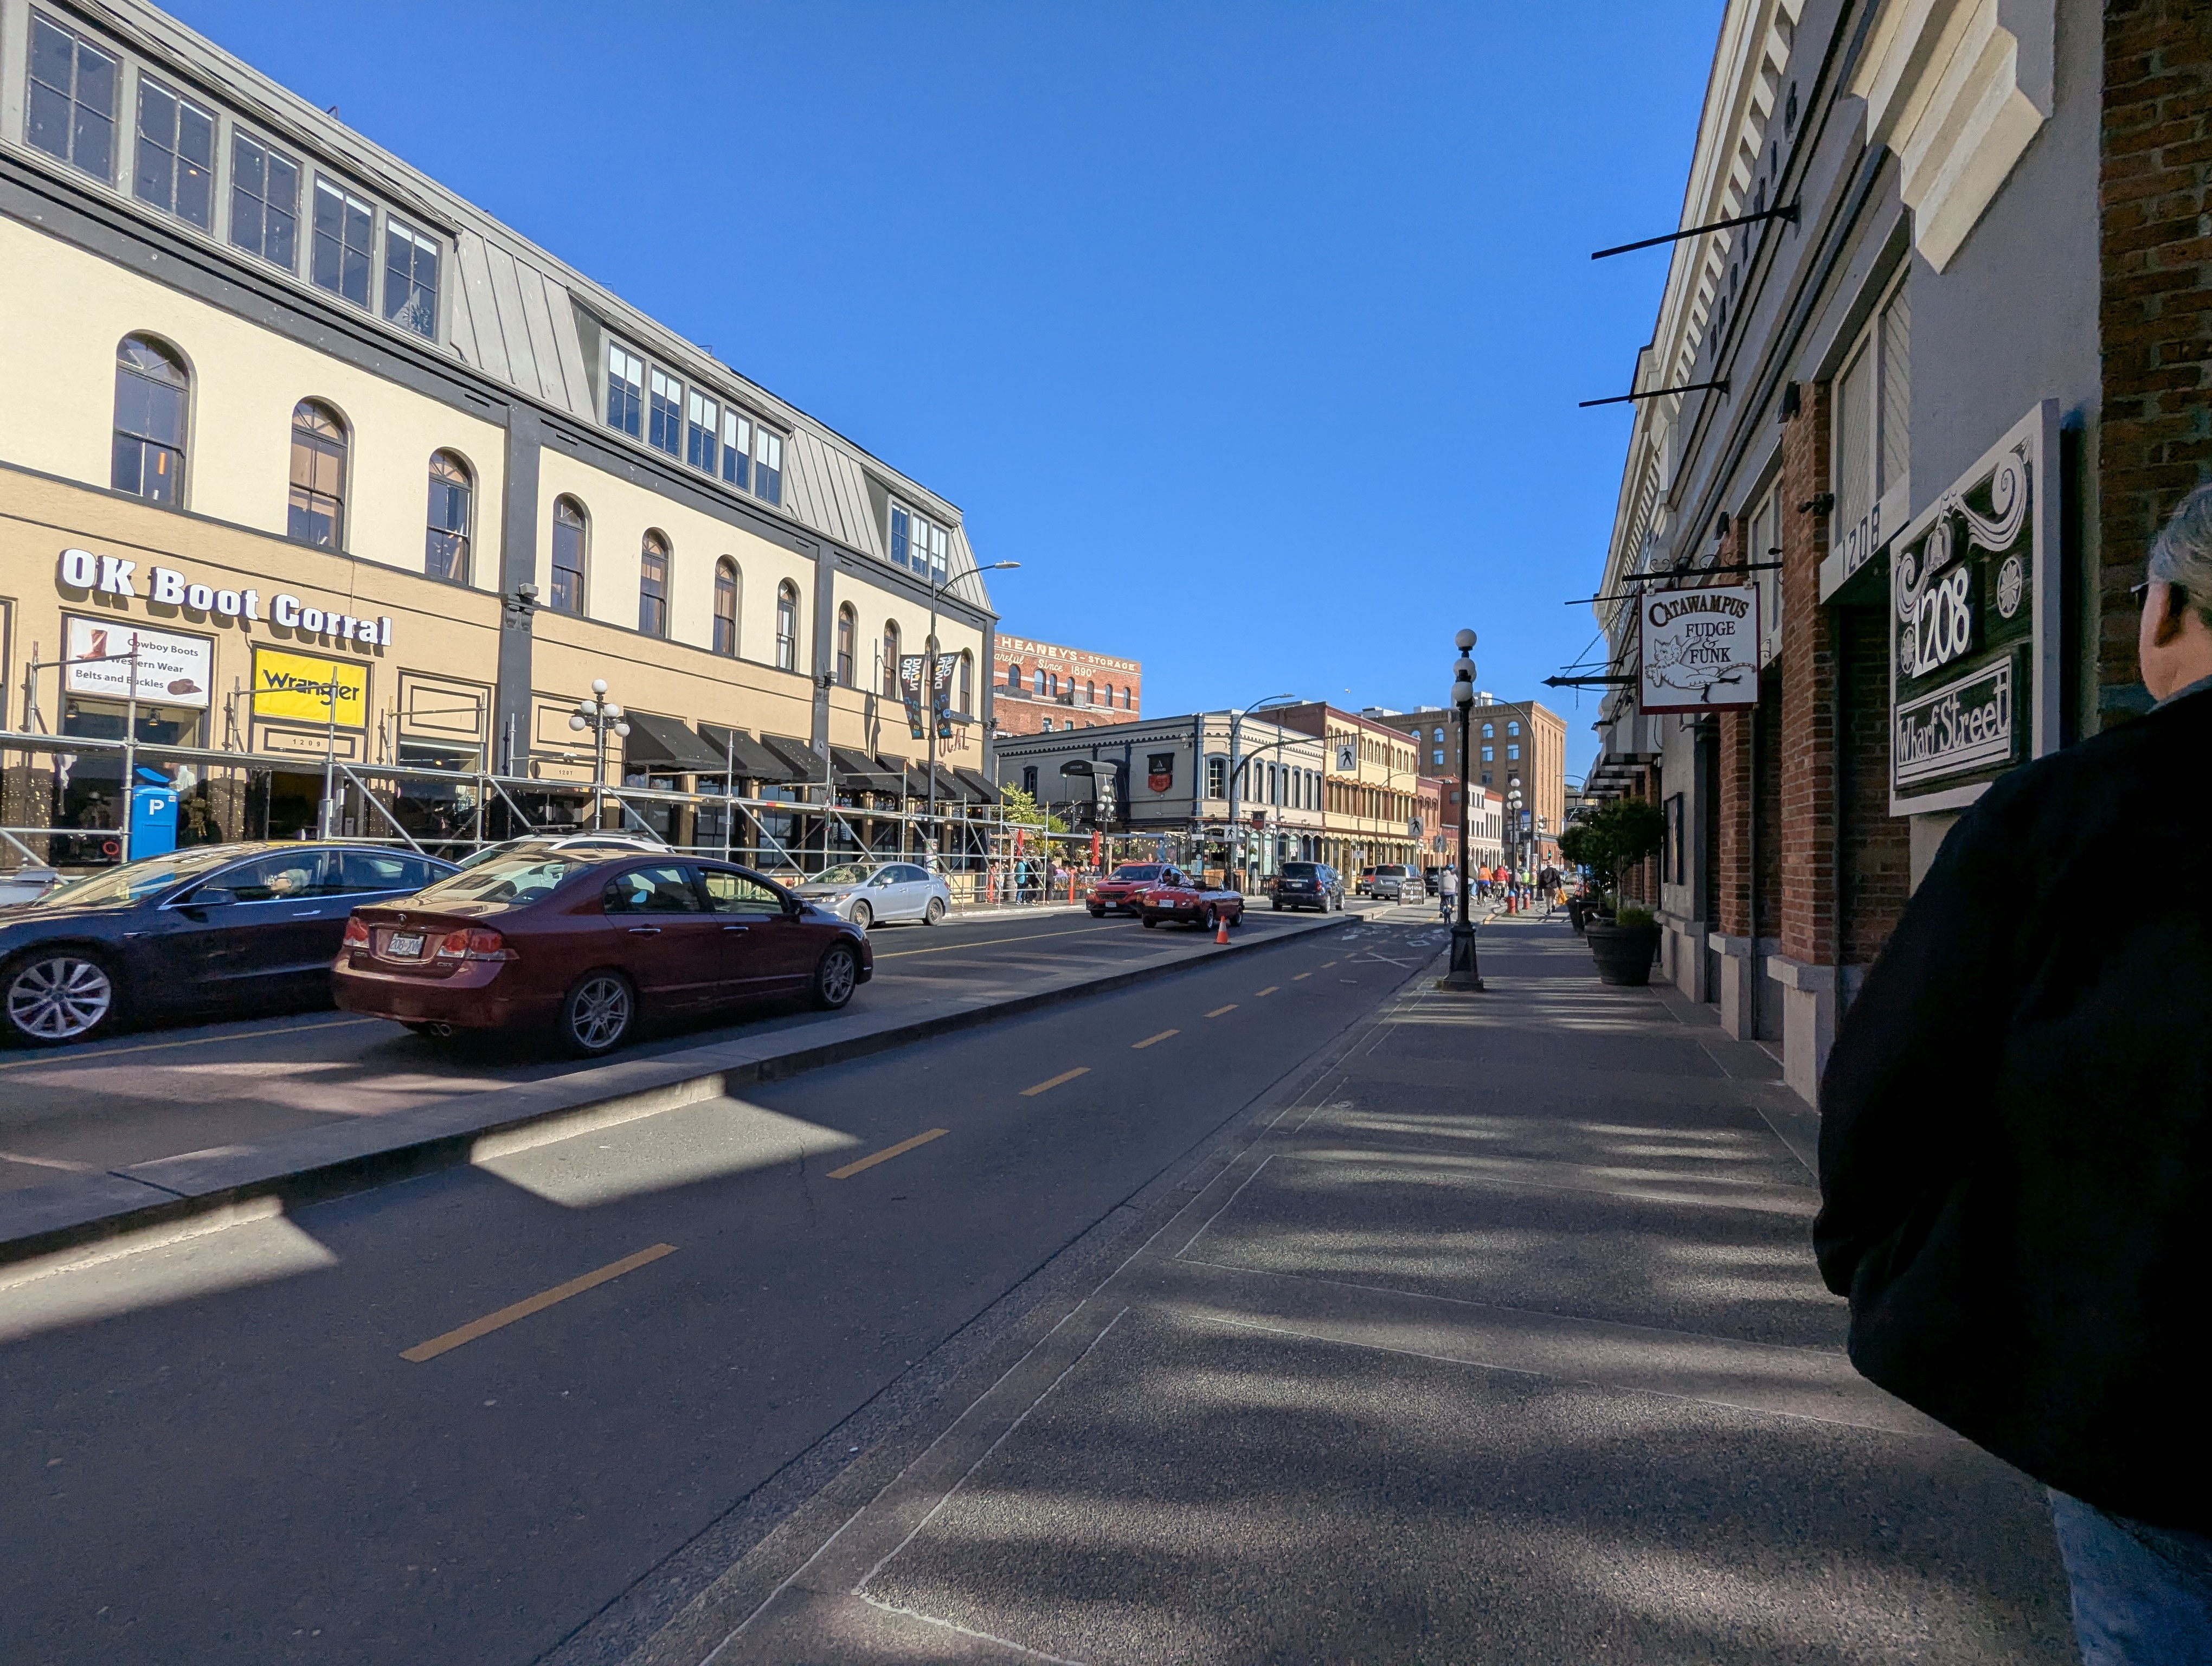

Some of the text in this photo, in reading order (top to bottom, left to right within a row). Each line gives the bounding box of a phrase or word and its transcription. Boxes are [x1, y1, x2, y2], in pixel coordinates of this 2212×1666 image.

[1843, 502, 1880, 580] 1208
[59, 548, 392, 646] OK Boot Corral
[1649, 594, 1750, 627] CATAWAMPUS
[1686, 621, 1735, 638] FUDGE
[1912, 567, 1970, 678] 1208
[171, 645, 199, 657] Boots
[1702, 636, 1719, 650] &
[994, 653, 1024, 666] areful
[1037, 659, 1064, 672] Since
[1001, 637, 1135, 671] HEANEY'S STORAGE
[1690, 647, 1732, 664] FUNK
[111, 657, 184, 673] Wesern Wear
[76, 669, 102, 681] Belts
[104, 674, 124, 683] and
[1898, 671, 2009, 764] Wharf Street
[149, 799, 165, 816] P
